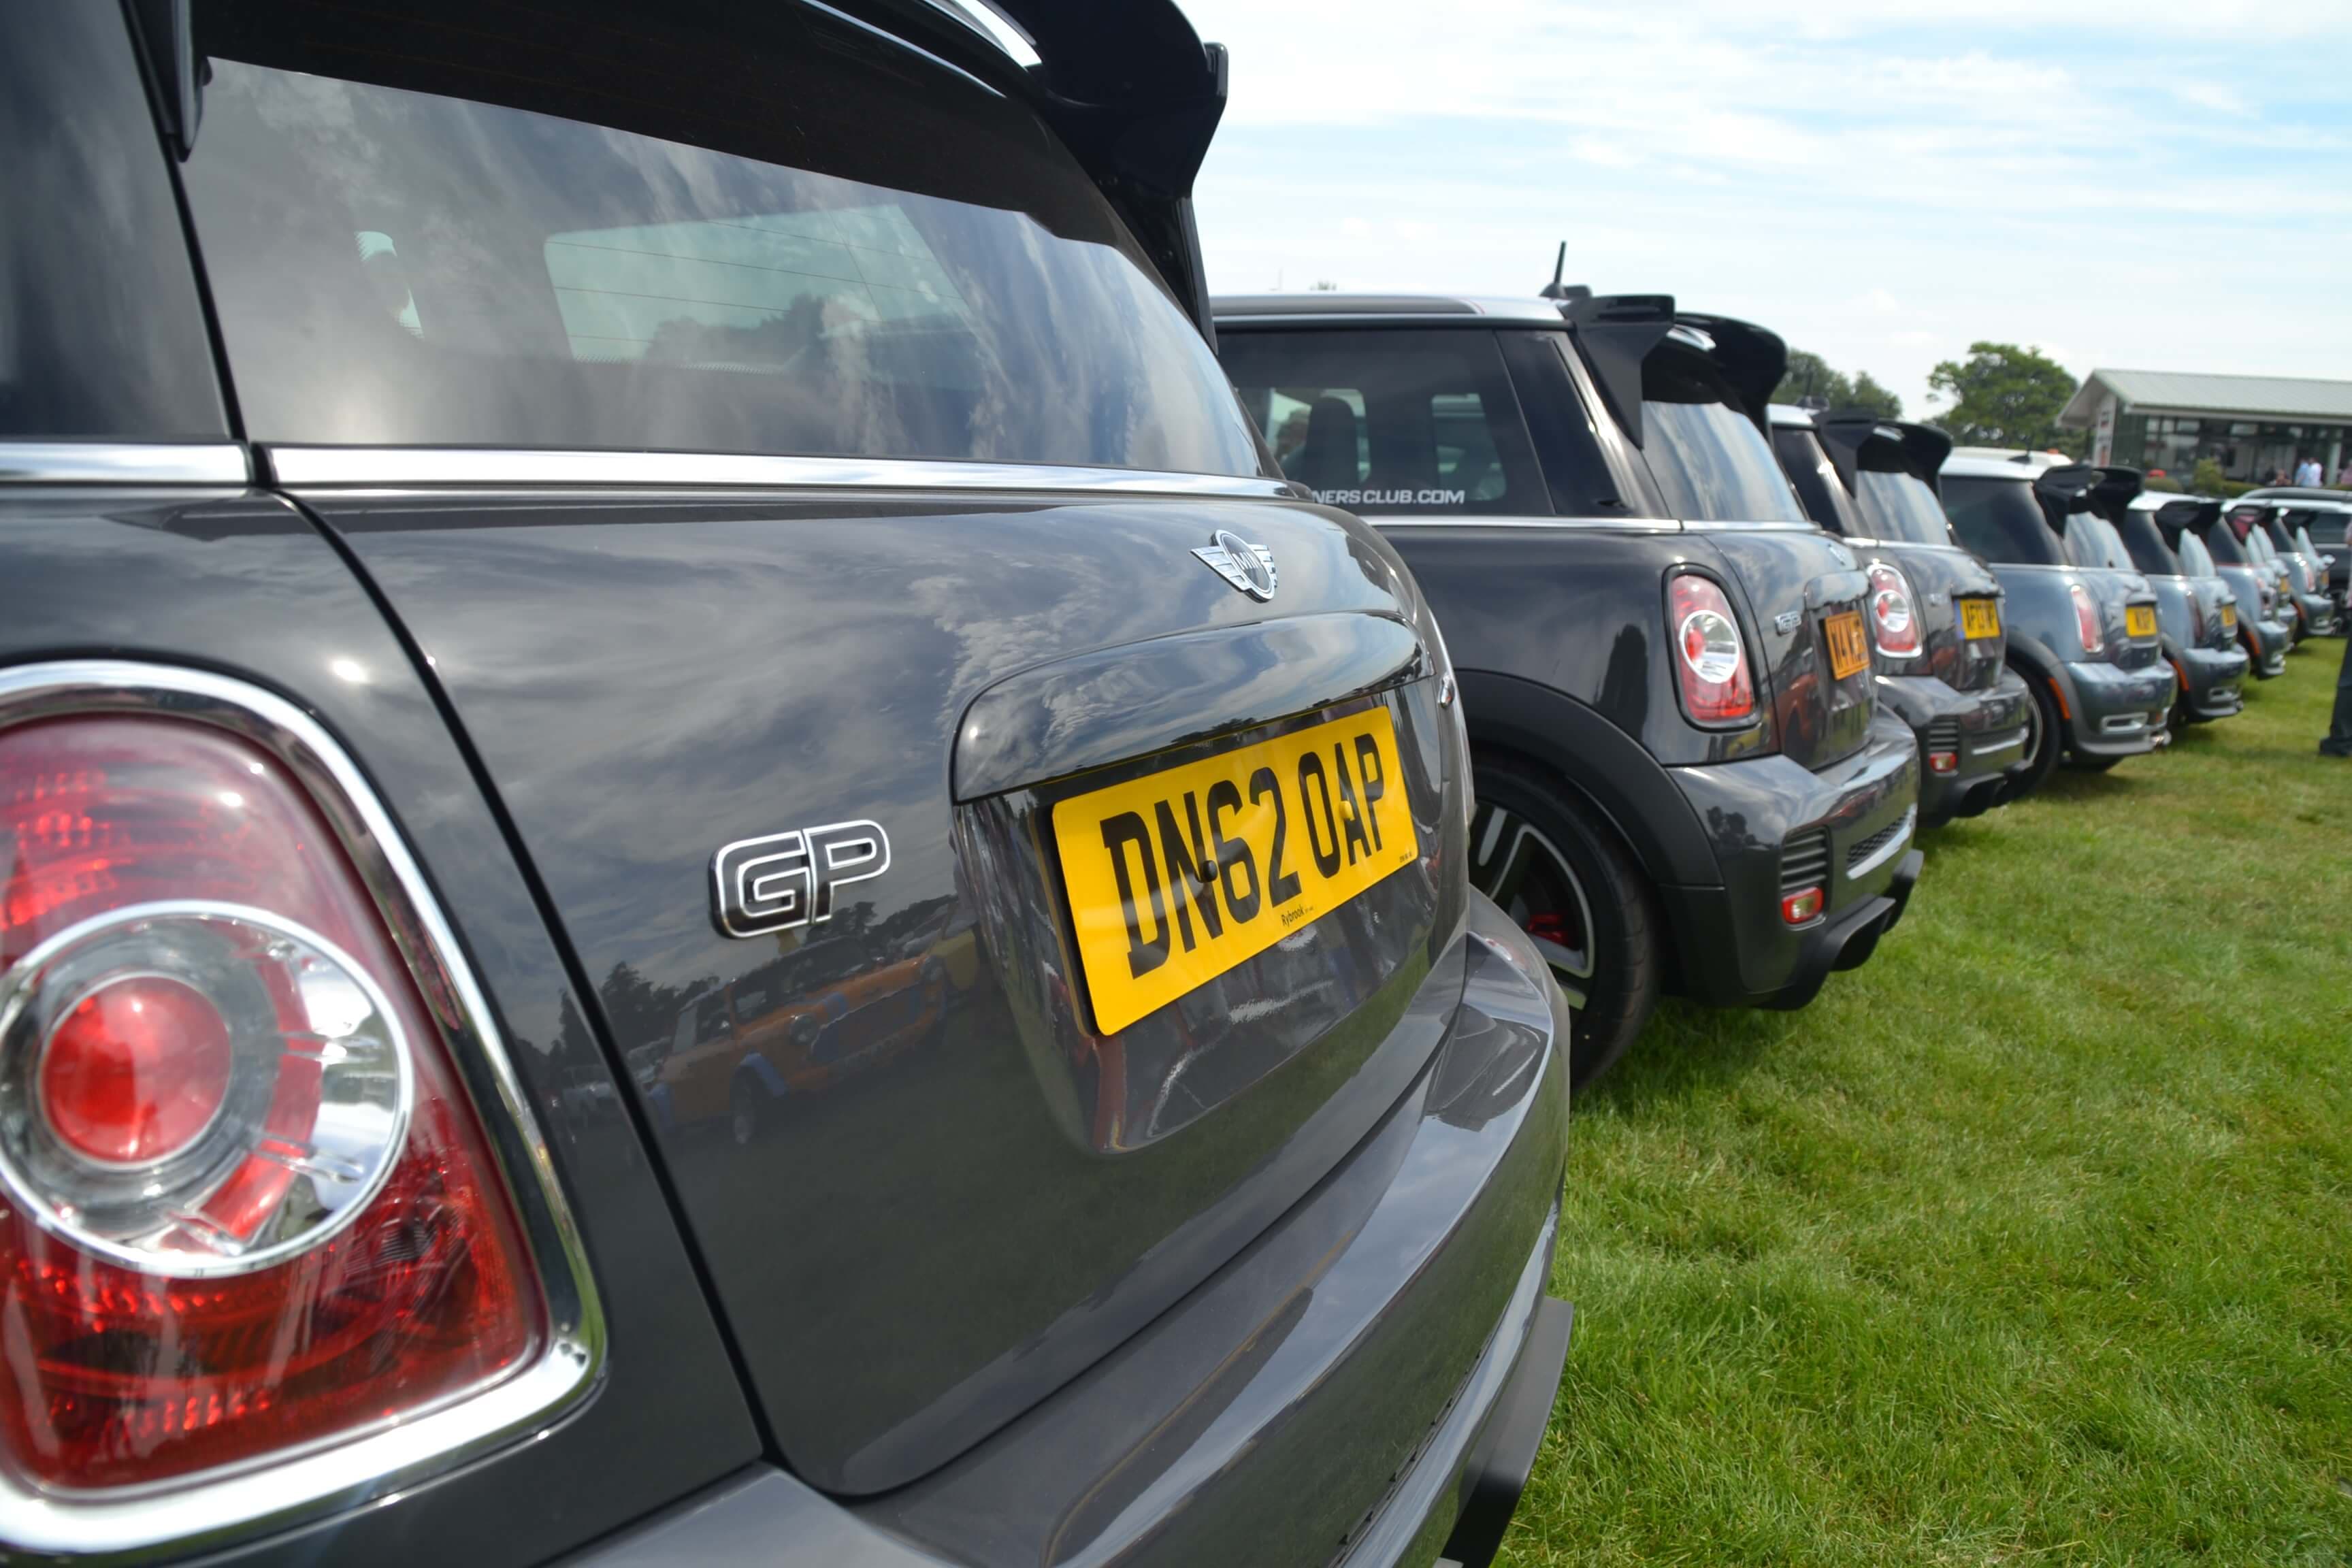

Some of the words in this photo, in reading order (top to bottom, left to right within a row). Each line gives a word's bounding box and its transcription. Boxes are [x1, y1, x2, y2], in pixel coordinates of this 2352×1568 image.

[710, 819, 892, 938] GP
[1099, 766, 1302, 980] DN62
[1298, 733, 1384, 879] OAP
[1281, 904, 1305, 927] Rybrook
